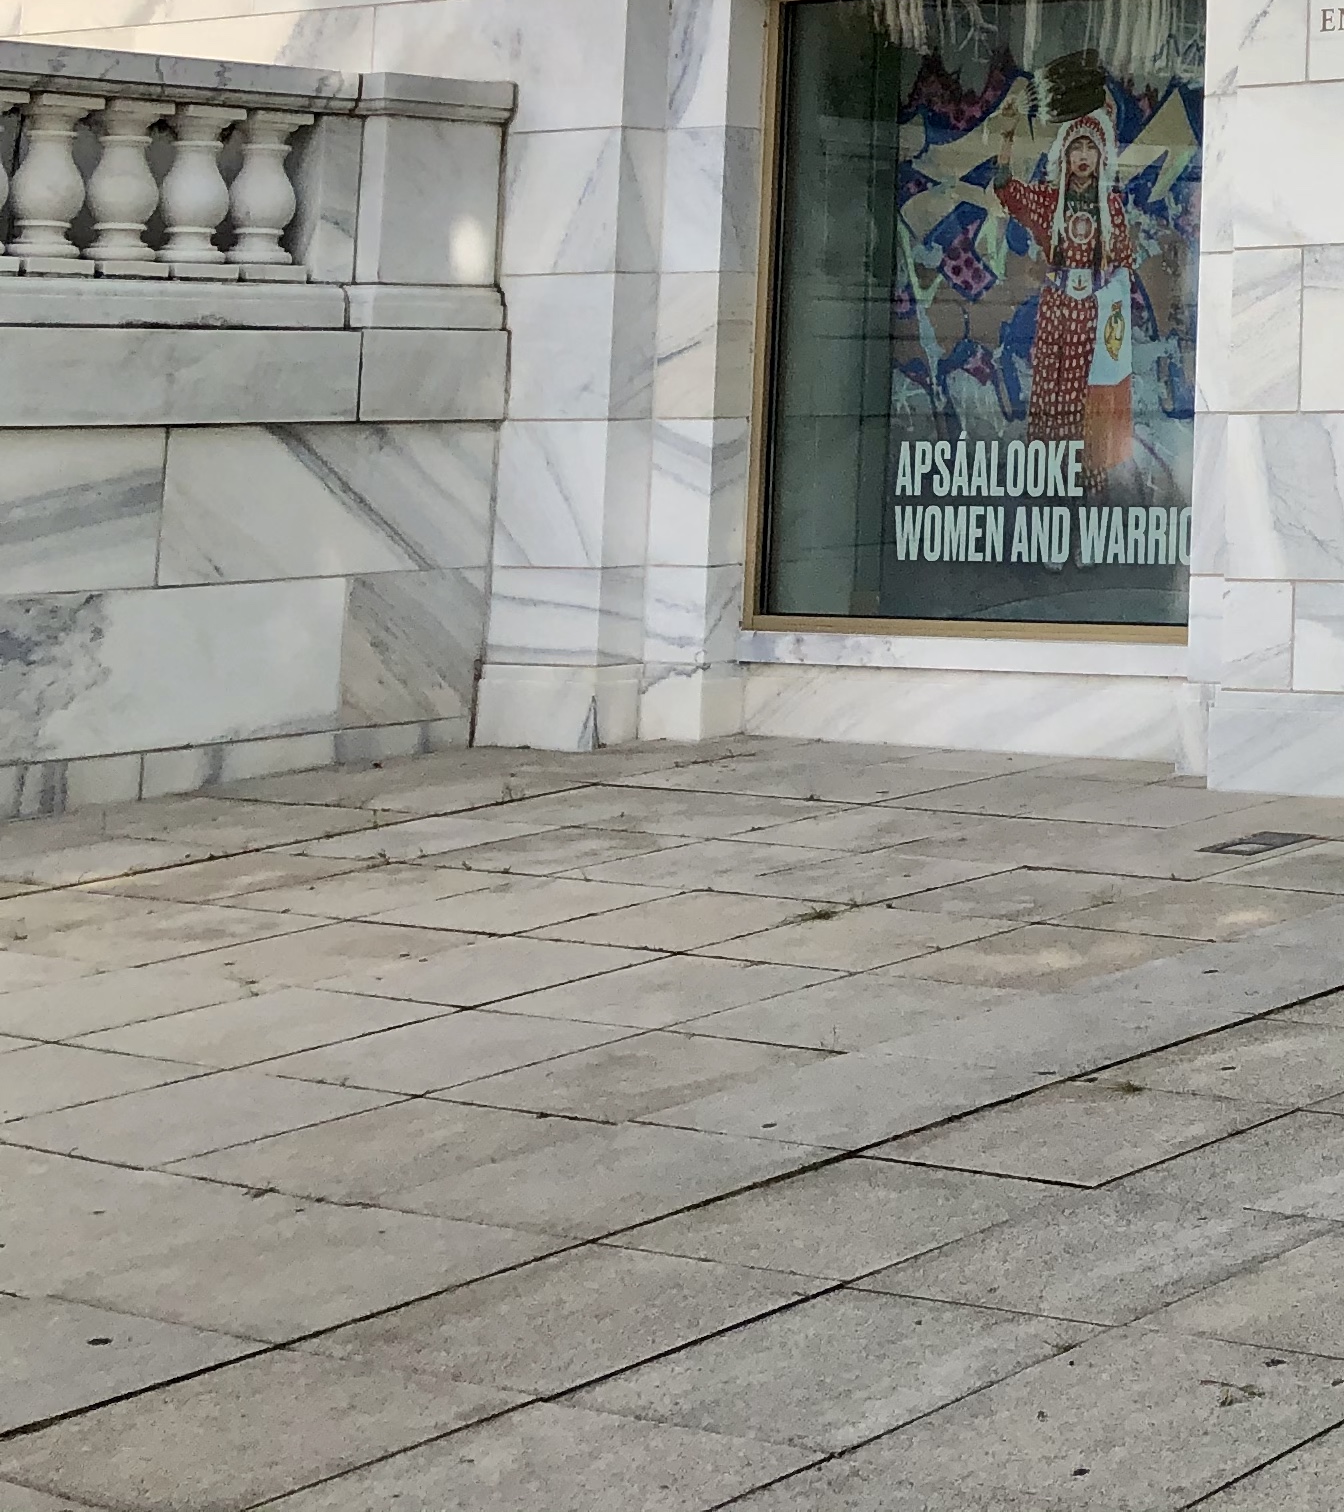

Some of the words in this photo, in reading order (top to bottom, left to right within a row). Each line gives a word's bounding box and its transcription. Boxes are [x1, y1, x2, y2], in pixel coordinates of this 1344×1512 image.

[894, 430, 1085, 497] APSÁALOOKE
[894, 504, 1005, 562] WOMEN
[1011, 505, 1071, 563] AND
